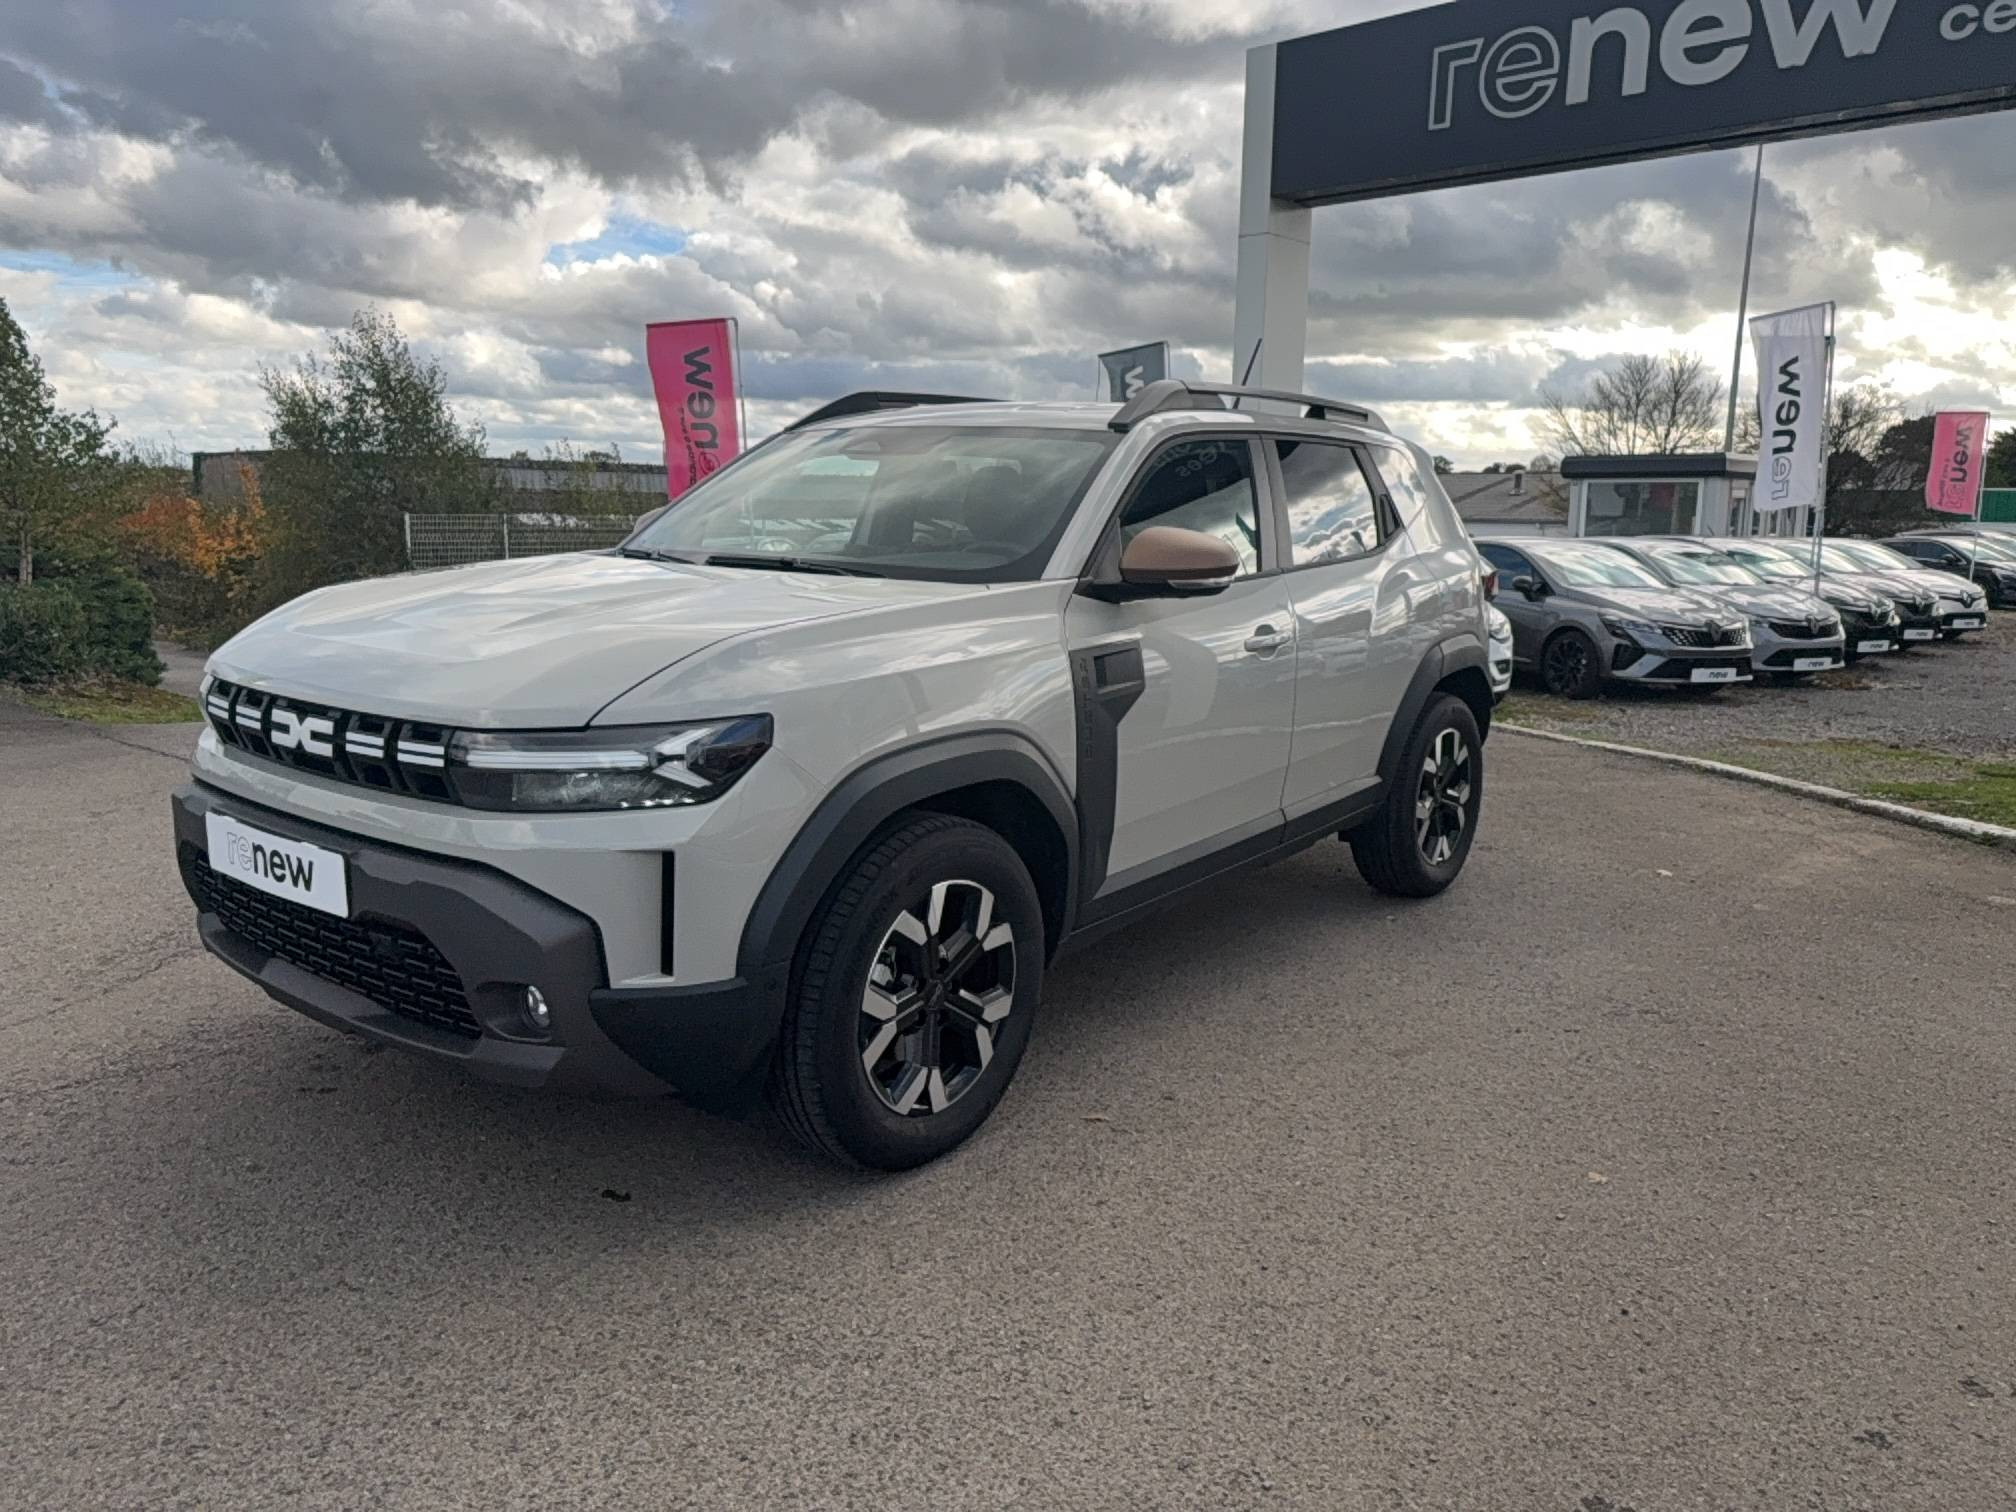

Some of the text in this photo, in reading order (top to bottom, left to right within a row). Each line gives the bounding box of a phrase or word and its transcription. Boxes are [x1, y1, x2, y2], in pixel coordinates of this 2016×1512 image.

[1428, 0, 2016, 131] renew ce
[227, 832, 313, 892] renew
